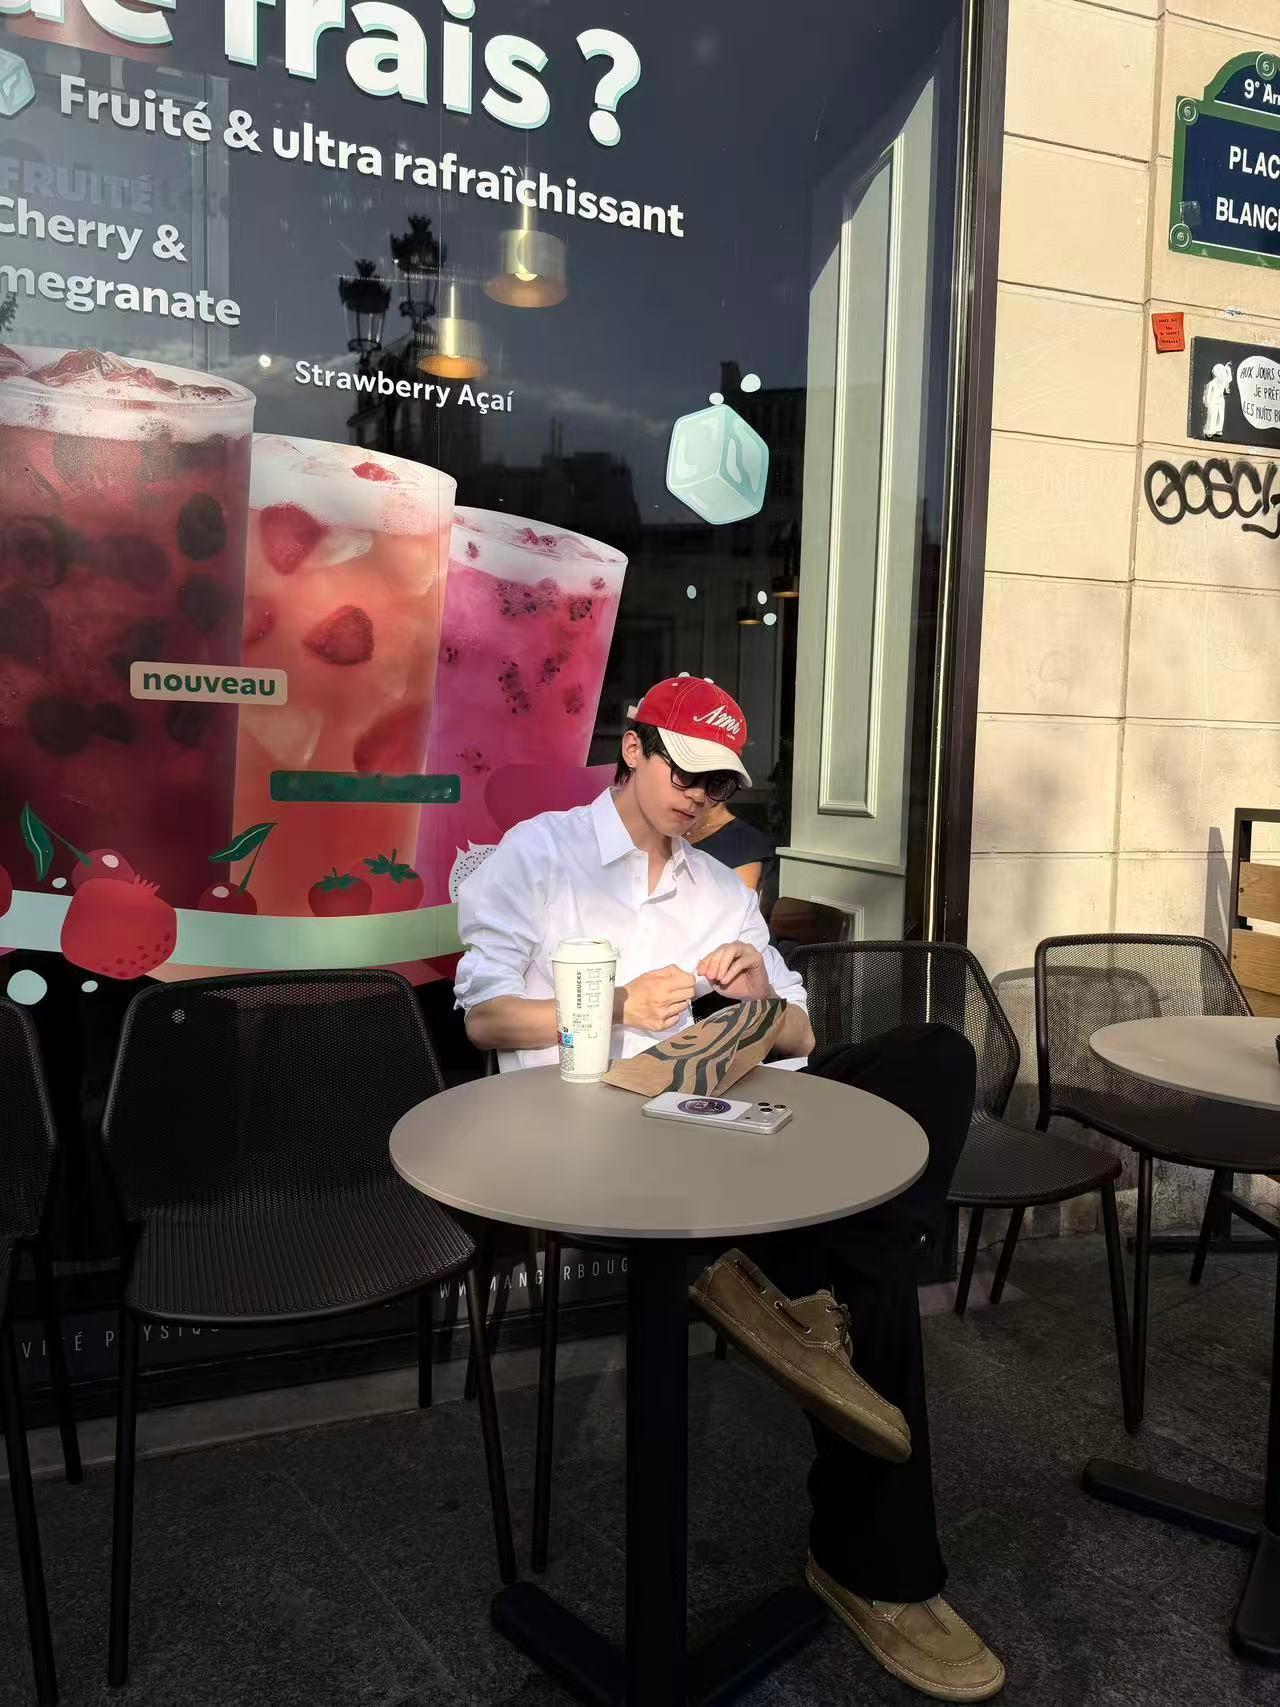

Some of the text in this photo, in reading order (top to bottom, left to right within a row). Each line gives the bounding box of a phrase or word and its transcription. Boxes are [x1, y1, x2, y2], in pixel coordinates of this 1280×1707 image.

[576, 28, 641, 147] ?
[60, 73, 684, 237] Fruité & ultra rafraîchissant
[1229, 145, 1280, 179] PLAC
[1216, 196, 1280, 232] BLANC
[152, 224, 188, 262] &
[295, 360, 514, 414] Strawberry Açaí
[1240, 366, 1254, 379] AUX
[1255, 364, 1275, 381] JOURS
[1253, 384, 1261, 398] JE
[1243, 401, 1254, 416] LES
[1255, 405, 1271, 421] NUITS
[143, 672, 276, 696] nouveau
